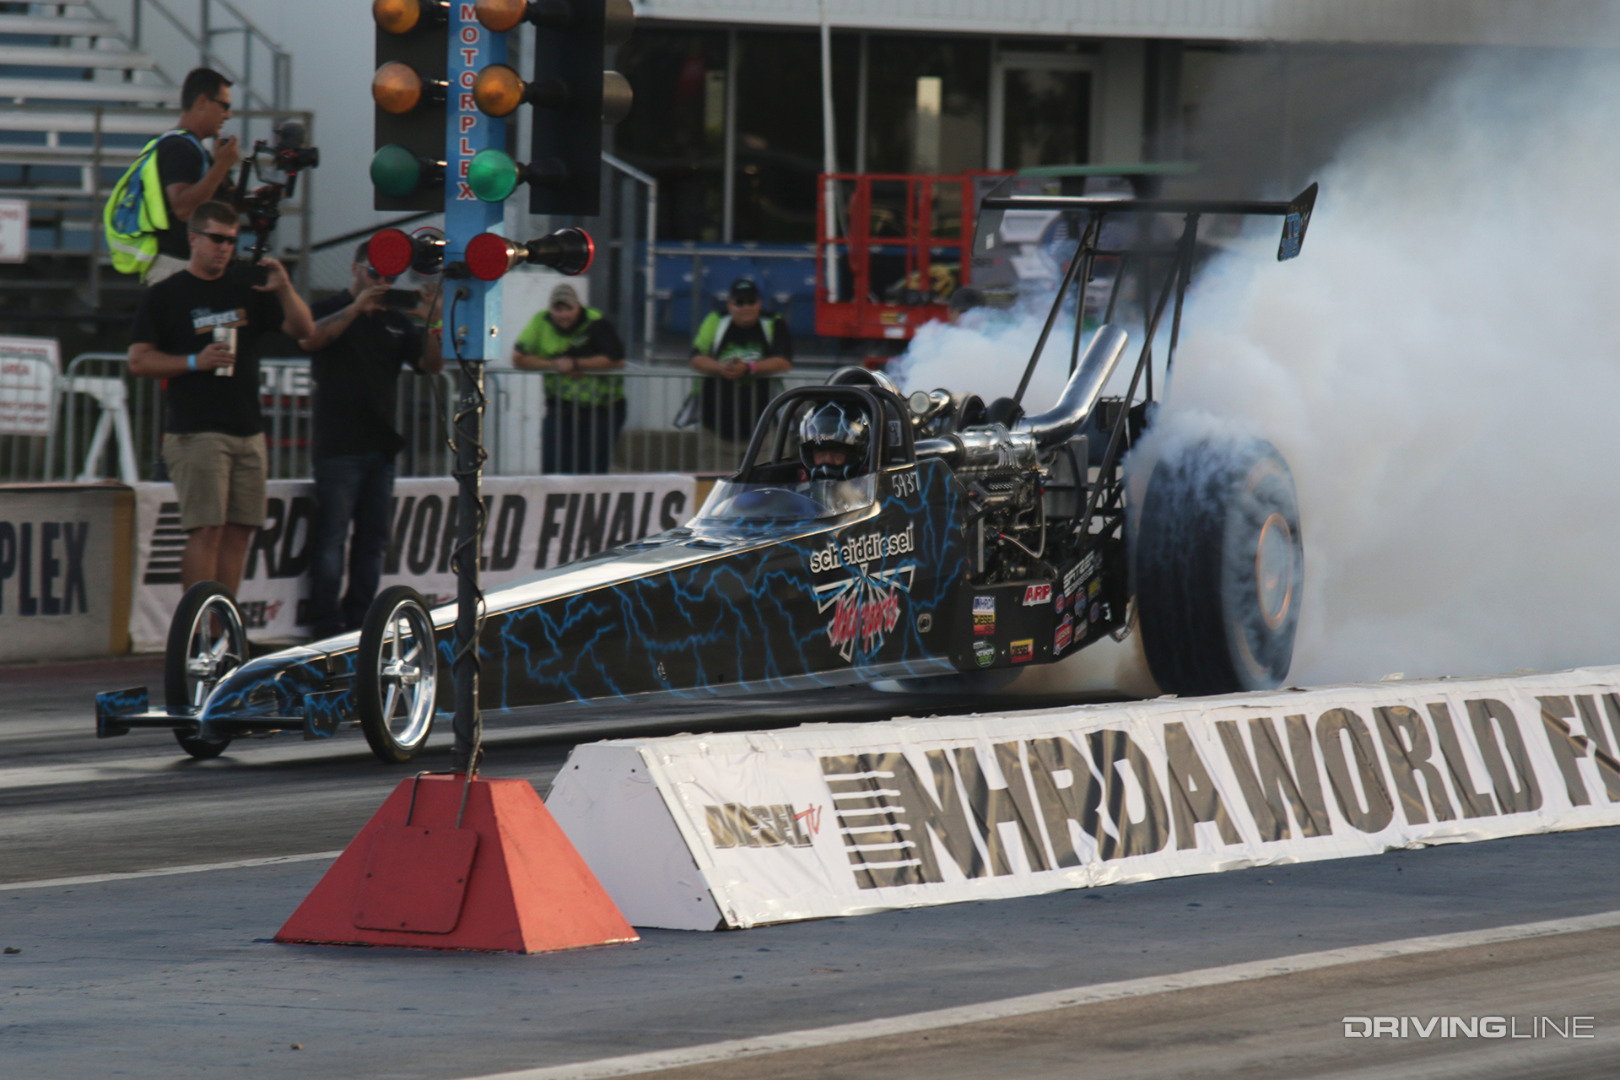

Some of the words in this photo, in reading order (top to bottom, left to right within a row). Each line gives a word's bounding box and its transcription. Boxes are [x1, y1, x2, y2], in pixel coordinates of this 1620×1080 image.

[458, 3, 480, 201] MOTORPLEX
[891, 471, 920, 499] 5937
[0, 521, 88, 617] PLEX
[809, 520, 915, 574] scheiddiesel
[1023, 585, 1052, 602] ARP
[860, 722, 1244, 886] NHRDA
[1215, 698, 1543, 845] WORLD
[704, 802, 813, 849] DIESEL
[793, 802, 823, 838] TV
